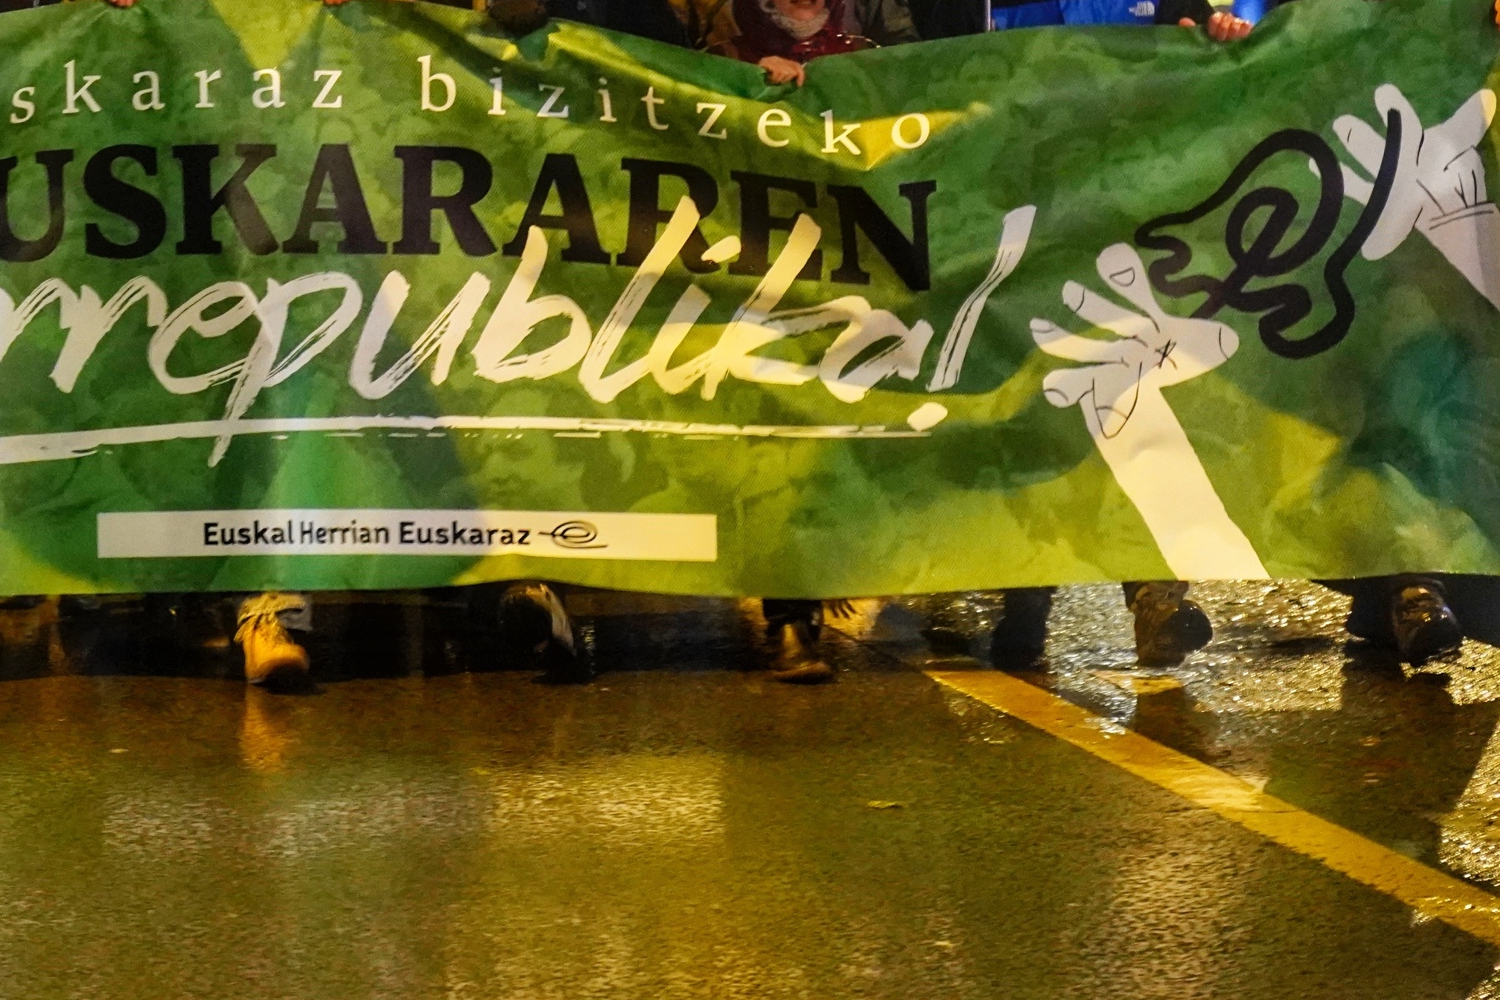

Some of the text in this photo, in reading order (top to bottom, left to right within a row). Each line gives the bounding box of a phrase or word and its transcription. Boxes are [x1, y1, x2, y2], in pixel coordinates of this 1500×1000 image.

[419, 55, 931, 156] bizitzeko
[203, 519, 531, 546] Euskal Herrian Euskaraz
